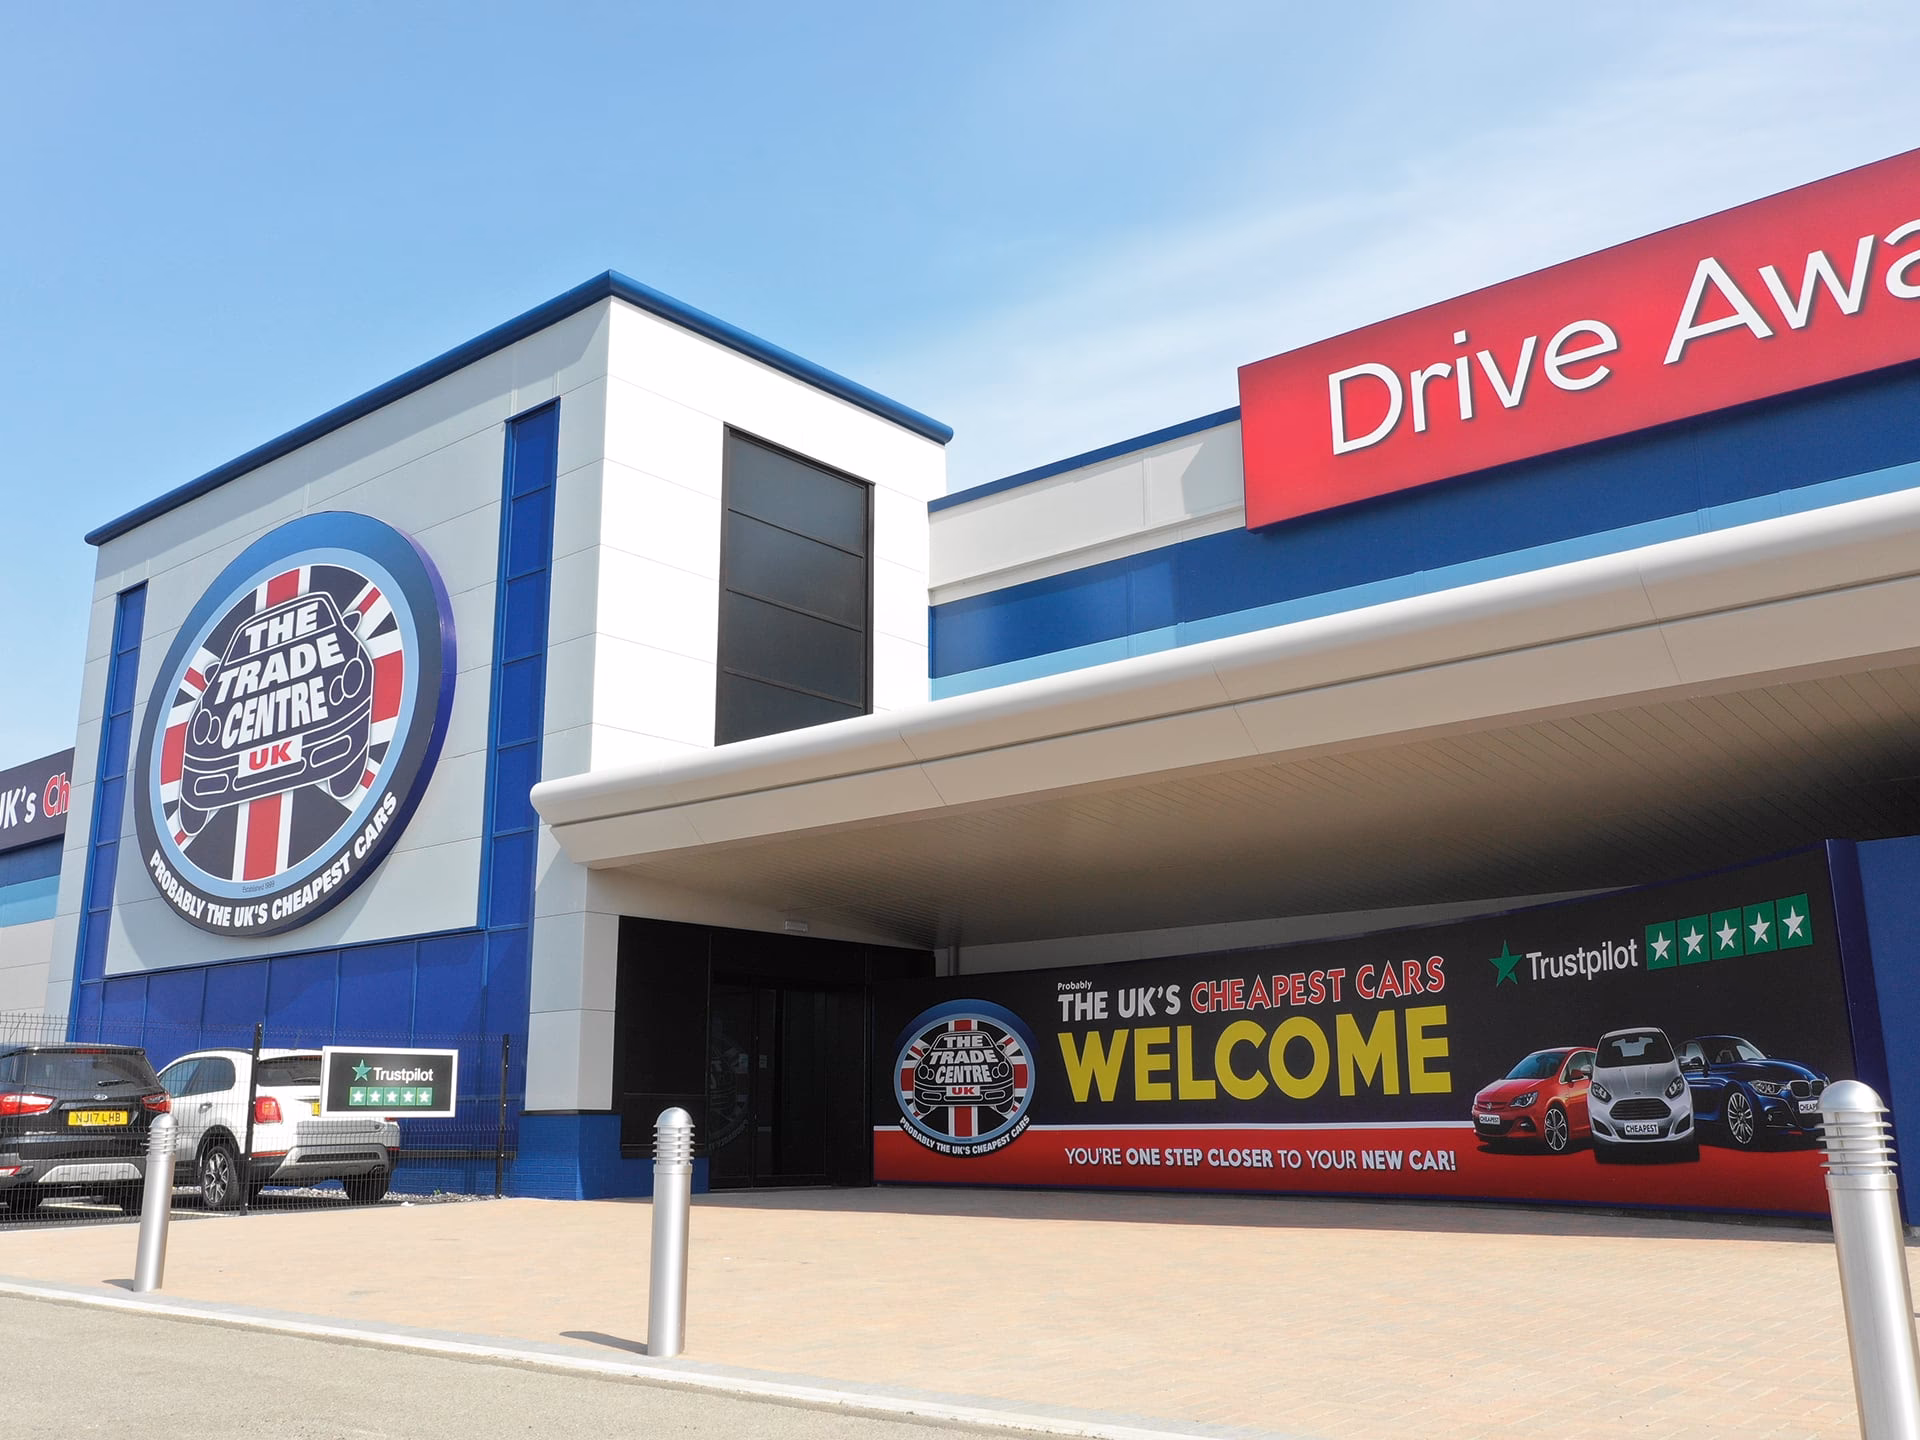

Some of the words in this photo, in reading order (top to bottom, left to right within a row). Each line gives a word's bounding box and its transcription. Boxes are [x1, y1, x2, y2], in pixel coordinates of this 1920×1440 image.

[1328, 319, 1618, 456] Drive
[245, 601, 319, 654] THE
[214, 632, 346, 706] TRADE
[221, 675, 329, 750] CENTRE
[249, 740, 292, 771] UK
[150, 849, 206, 918] PROBABLY
[206, 903, 231, 928] THE
[234, 902, 269, 928] UK'S
[271, 853, 352, 921] CHEAPEST
[354, 791, 397, 860] CARS
[1526, 938, 1639, 981] Trustpilot
[1057, 980, 1093, 991] Probably
[1057, 990, 1109, 1022] THE
[1118, 984, 1181, 1019] UK'S
[1190, 967, 1346, 1014] CHEAPEST
[1355, 955, 1446, 1000] CARS
[929, 1049, 999, 1065] TRADE
[943, 1035, 983, 1048] THE
[1057, 1004, 1452, 1102] WELCOME
[373, 1066, 434, 1084] Trustpilot
[935, 1064, 992, 1084] CENTRE
[952, 1086, 975, 1095] UK
[75, 1112, 99, 1123] NJ17
[102, 1112, 121, 1123] LHB
[1625, 1124, 1659, 1134] CHEAPEST
[900, 1116, 936, 1148] PROBABLY
[936, 1142, 951, 1153] THE
[952, 1145, 971, 1154] UK'S
[972, 1134, 1011, 1154] CHEAPEST
[1011, 1115, 1030, 1137] CARS
[1126, 1148, 1161, 1166] ONE
[1165, 1148, 1203, 1166] STEP
[1207, 1149, 1273, 1168] CLOSER
[1277, 1149, 1302, 1168] TO
[1306, 1150, 1357, 1169] YOUR
[1361, 1150, 1403, 1170] NEW
[1408, 1150, 1457, 1171] CAR!
